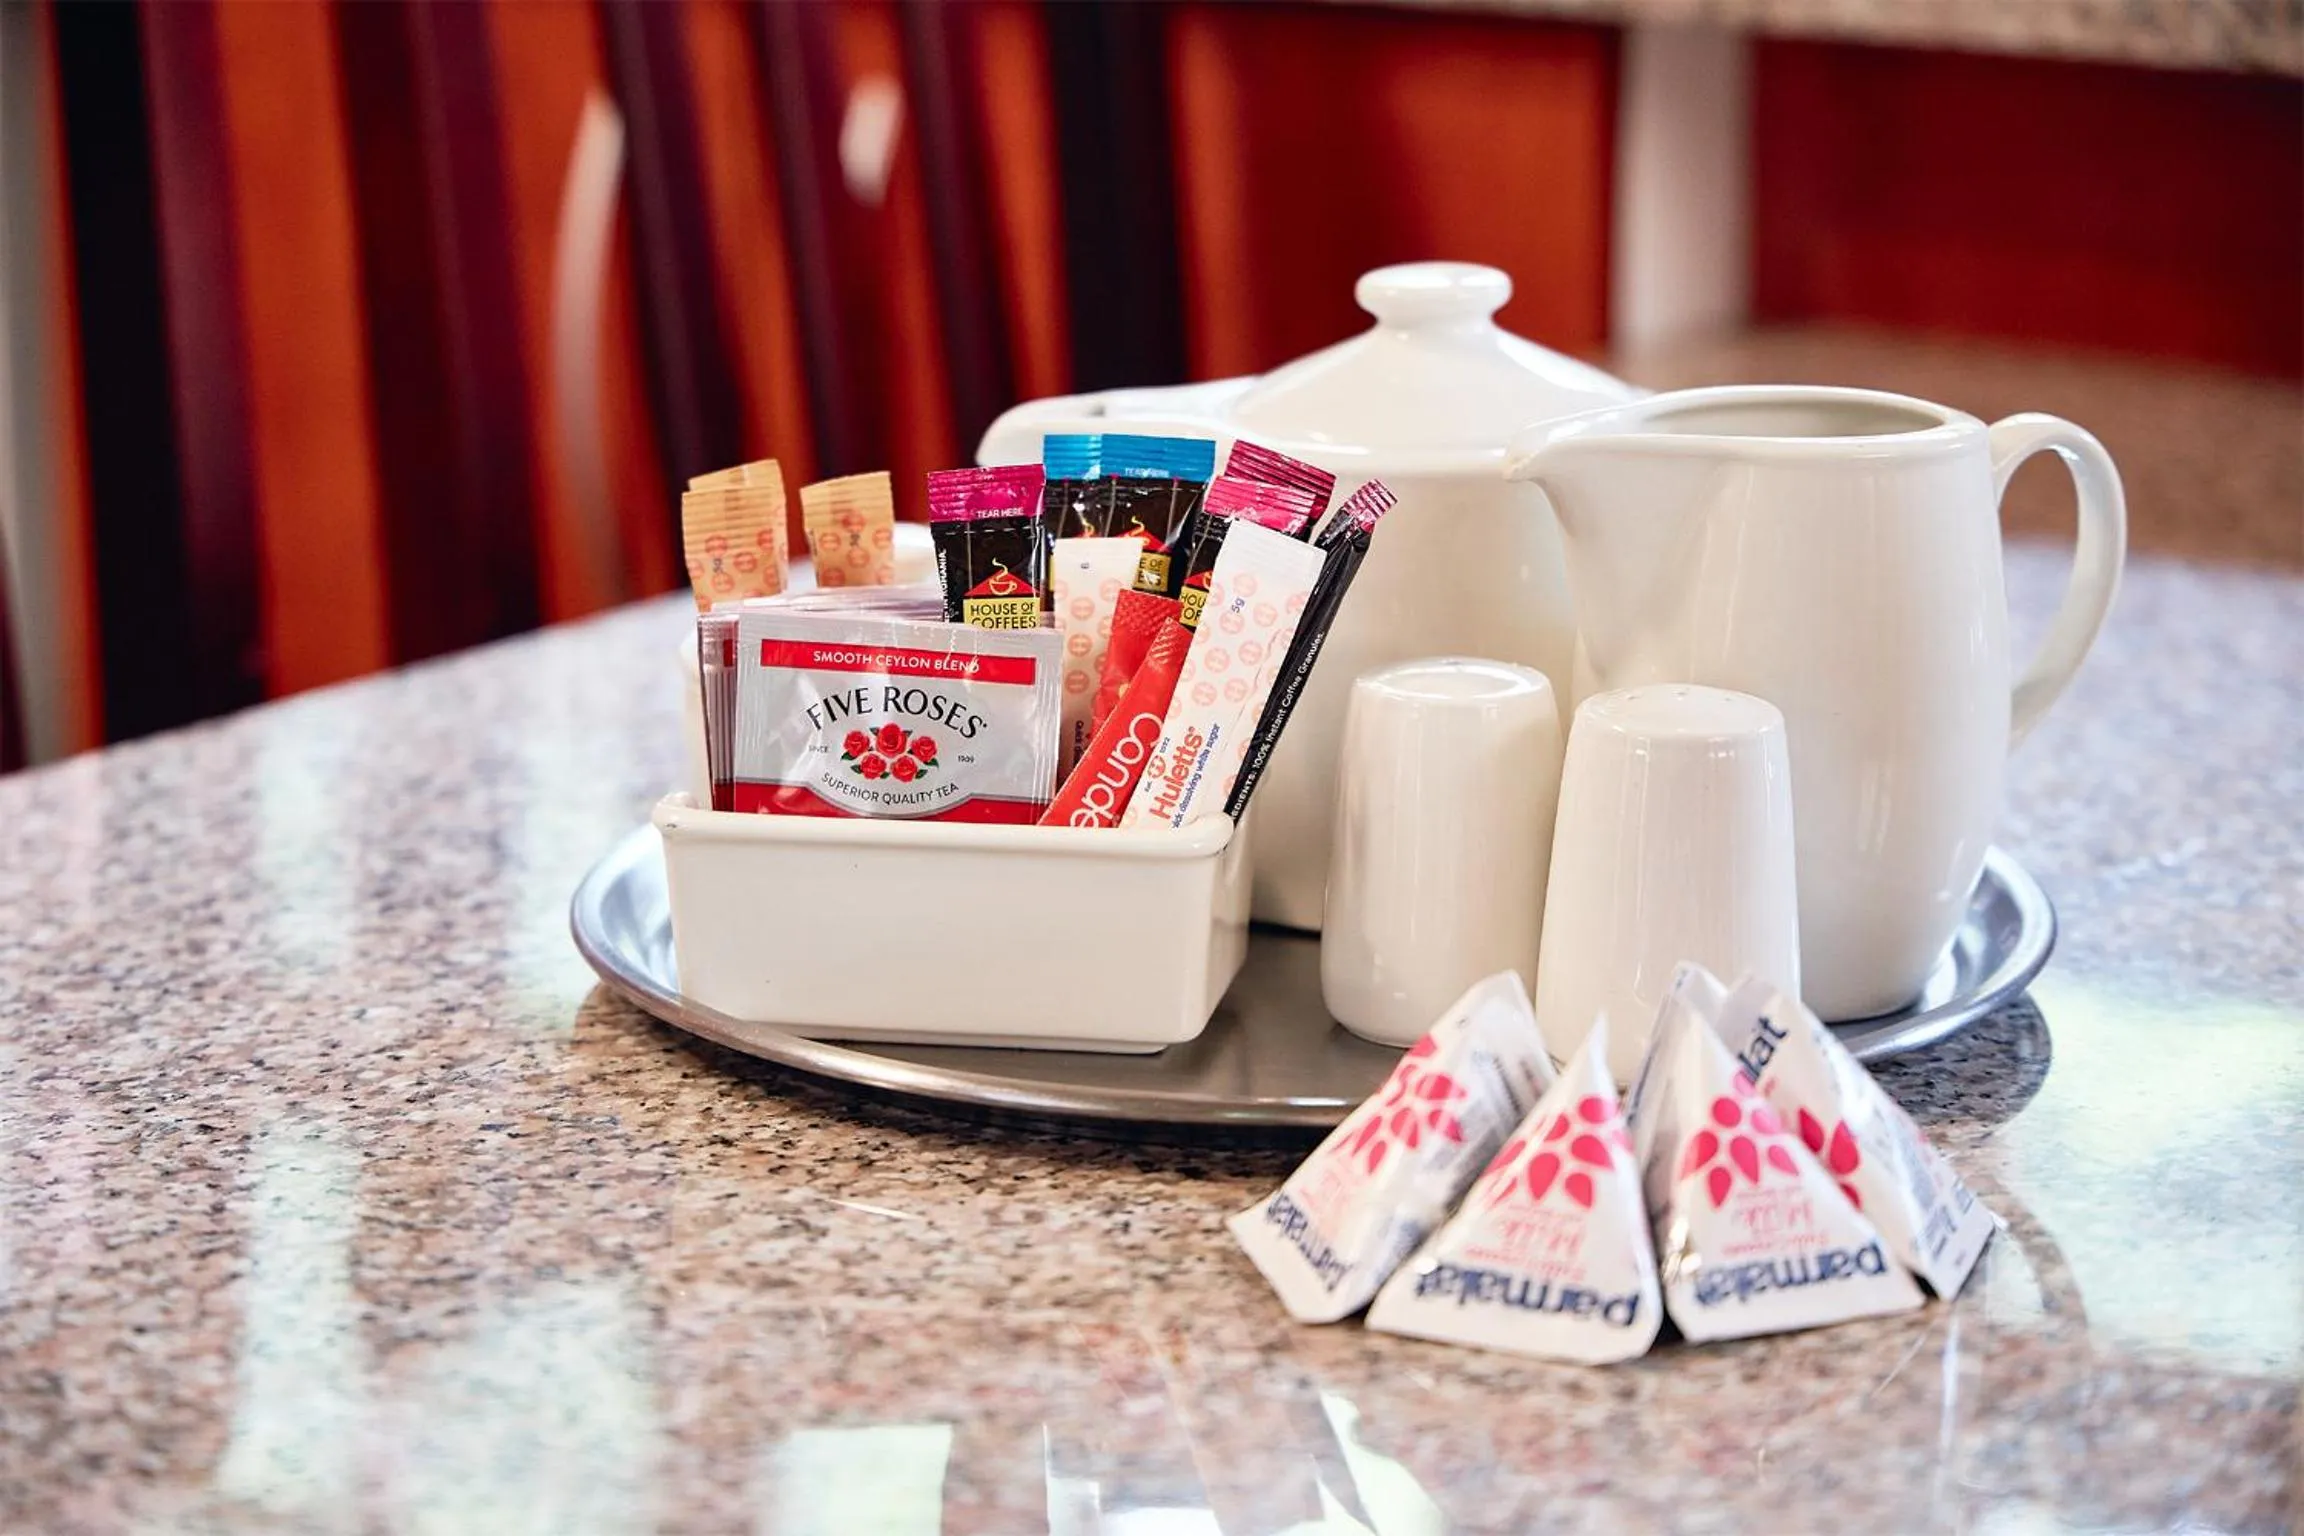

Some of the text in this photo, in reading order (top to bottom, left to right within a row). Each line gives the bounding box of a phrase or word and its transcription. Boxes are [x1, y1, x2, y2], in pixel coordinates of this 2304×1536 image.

[977, 508, 1024, 519] TEAR HERE
[1150, 558, 1164, 569] OF
[970, 603, 1018, 616] HOUSE
[1181, 590, 1206, 609] HOU
[1231, 598, 1246, 613] 5g
[971, 616, 1036, 629] COFFEES
[813, 650, 980, 673] SMOOTH CEYLON BLEND
[806, 686, 983, 739] FIVE ROSES
[1231, 772, 1257, 820] EDIENTS:
[1253, 744, 1271, 769] 100%
[1265, 709, 1288, 743] Instant
[1282, 675, 1302, 708] Coffee
[1070, 712, 1162, 828] Cande
[1179, 772, 1202, 813] dissolving
[1196, 749, 1211, 772] white
[1206, 722, 1221, 748] sugar
[822, 771, 959, 805] SUPERIOR QUALITY TEA
[1694, 1241, 1888, 1308] parmalat
[1415, 1259, 1640, 1328] parmalat
